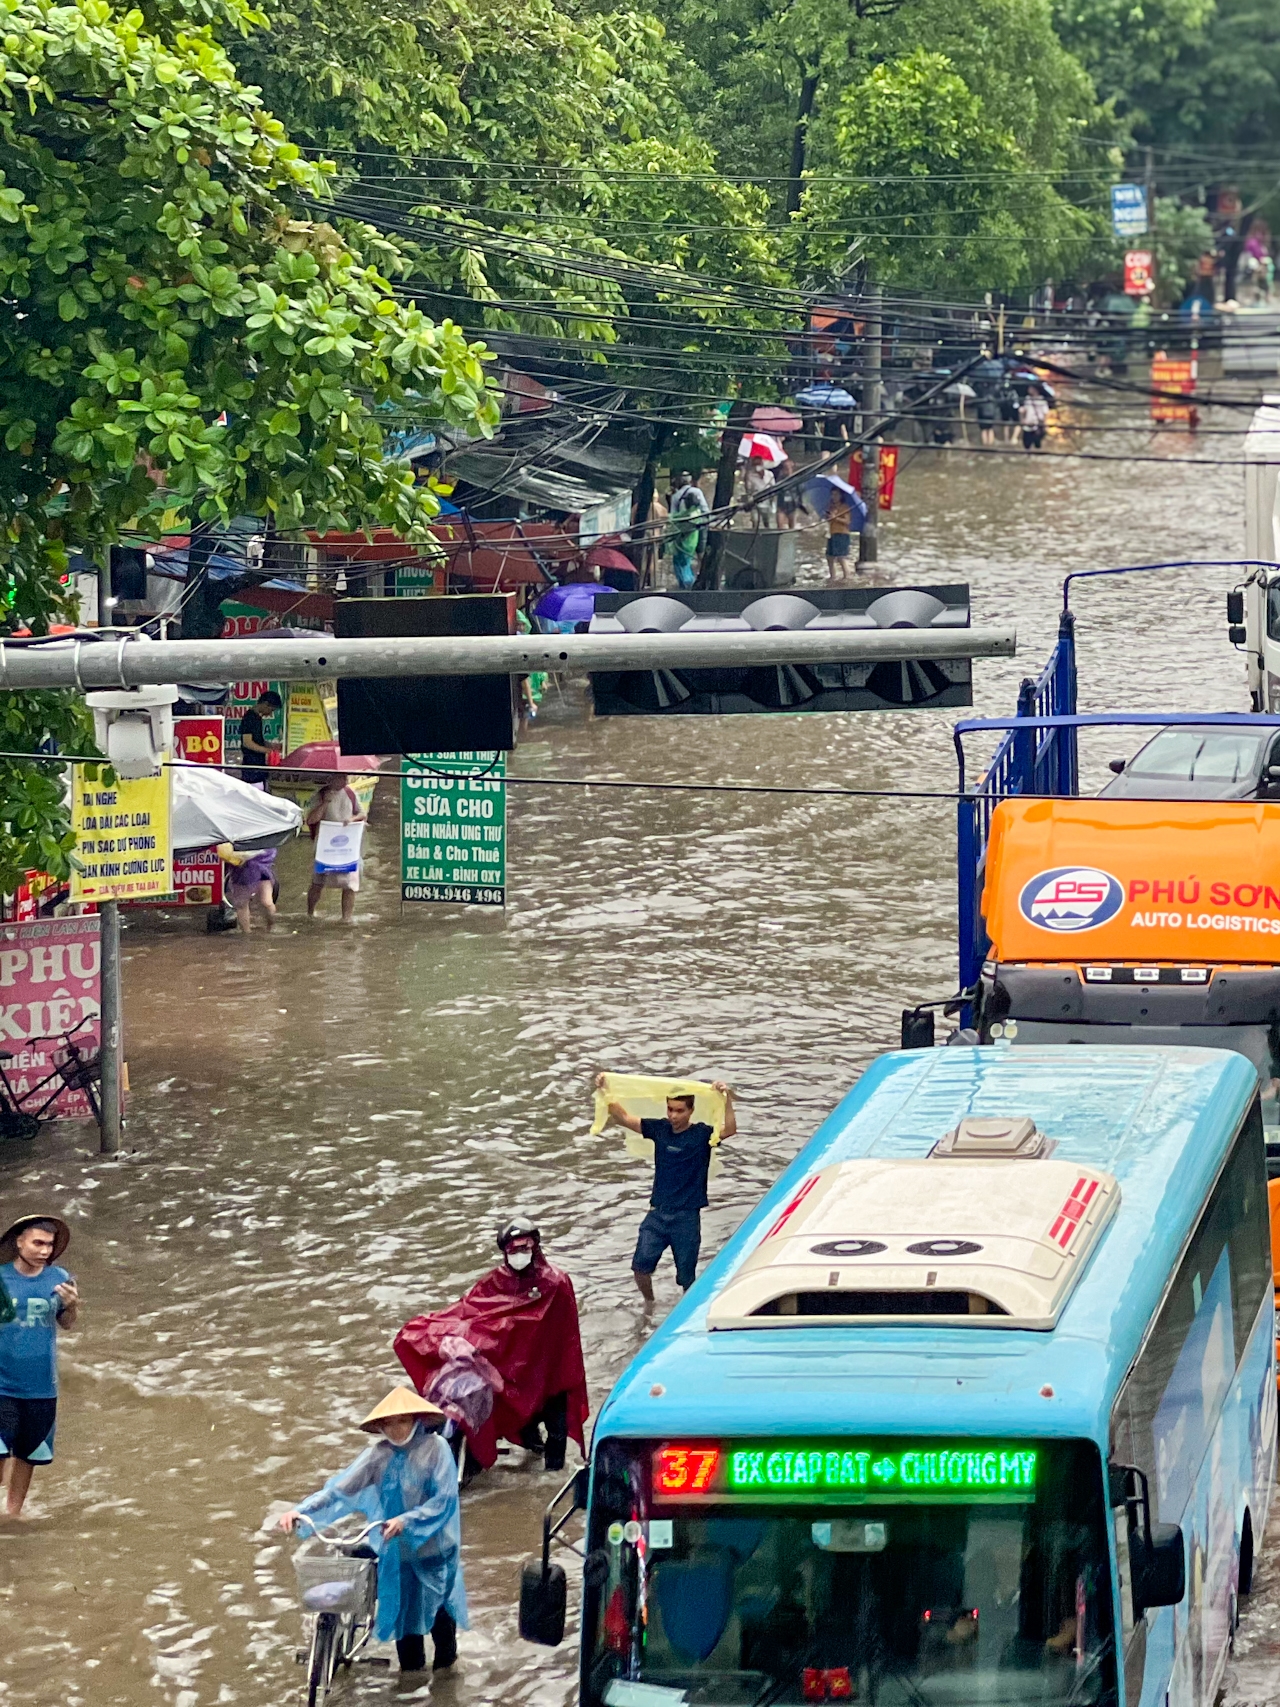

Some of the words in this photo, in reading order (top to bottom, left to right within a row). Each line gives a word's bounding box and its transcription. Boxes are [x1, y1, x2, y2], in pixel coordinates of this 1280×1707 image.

[186, 731, 220, 753] BÒ
[406, 767, 501, 792] CHUYÊN
[83, 793, 93, 806] TAI
[96, 791, 117, 805] NGHE
[414, 793, 451, 817] SỮA
[457, 798, 494, 818] CHO
[82, 815, 97, 831] LOA
[404, 819, 430, 841] BỆNH
[432, 821, 459, 840] NHÂN
[461, 825, 481, 841] UNG
[483, 825, 503, 842] THƯ
[82, 842, 95, 855] PIN
[97, 840, 115, 856] SẠC
[128, 834, 156, 851] PHÒNG
[407, 843, 430, 860] Bán
[433, 845, 443, 860] &
[446, 845, 469, 861] Cho
[472, 846, 500, 863] Thuê
[100, 860, 121, 877] KÍNH
[150, 857, 165, 876] LỰC
[198, 850, 219, 866] SẢN
[406, 866, 420, 879] XE
[422, 865, 444, 881] LĂN
[452, 866, 479, 883] BÌNH
[481, 869, 501, 884] OXY
[475, 888, 502, 903] 496
[1129, 875, 1200, 903] PHÚ
[1131, 911, 1182, 928] AUTO
[0, 942, 100, 990] PHỤ
[660, 1449, 719, 1489] 37
[732, 1451, 764, 1484] BX
